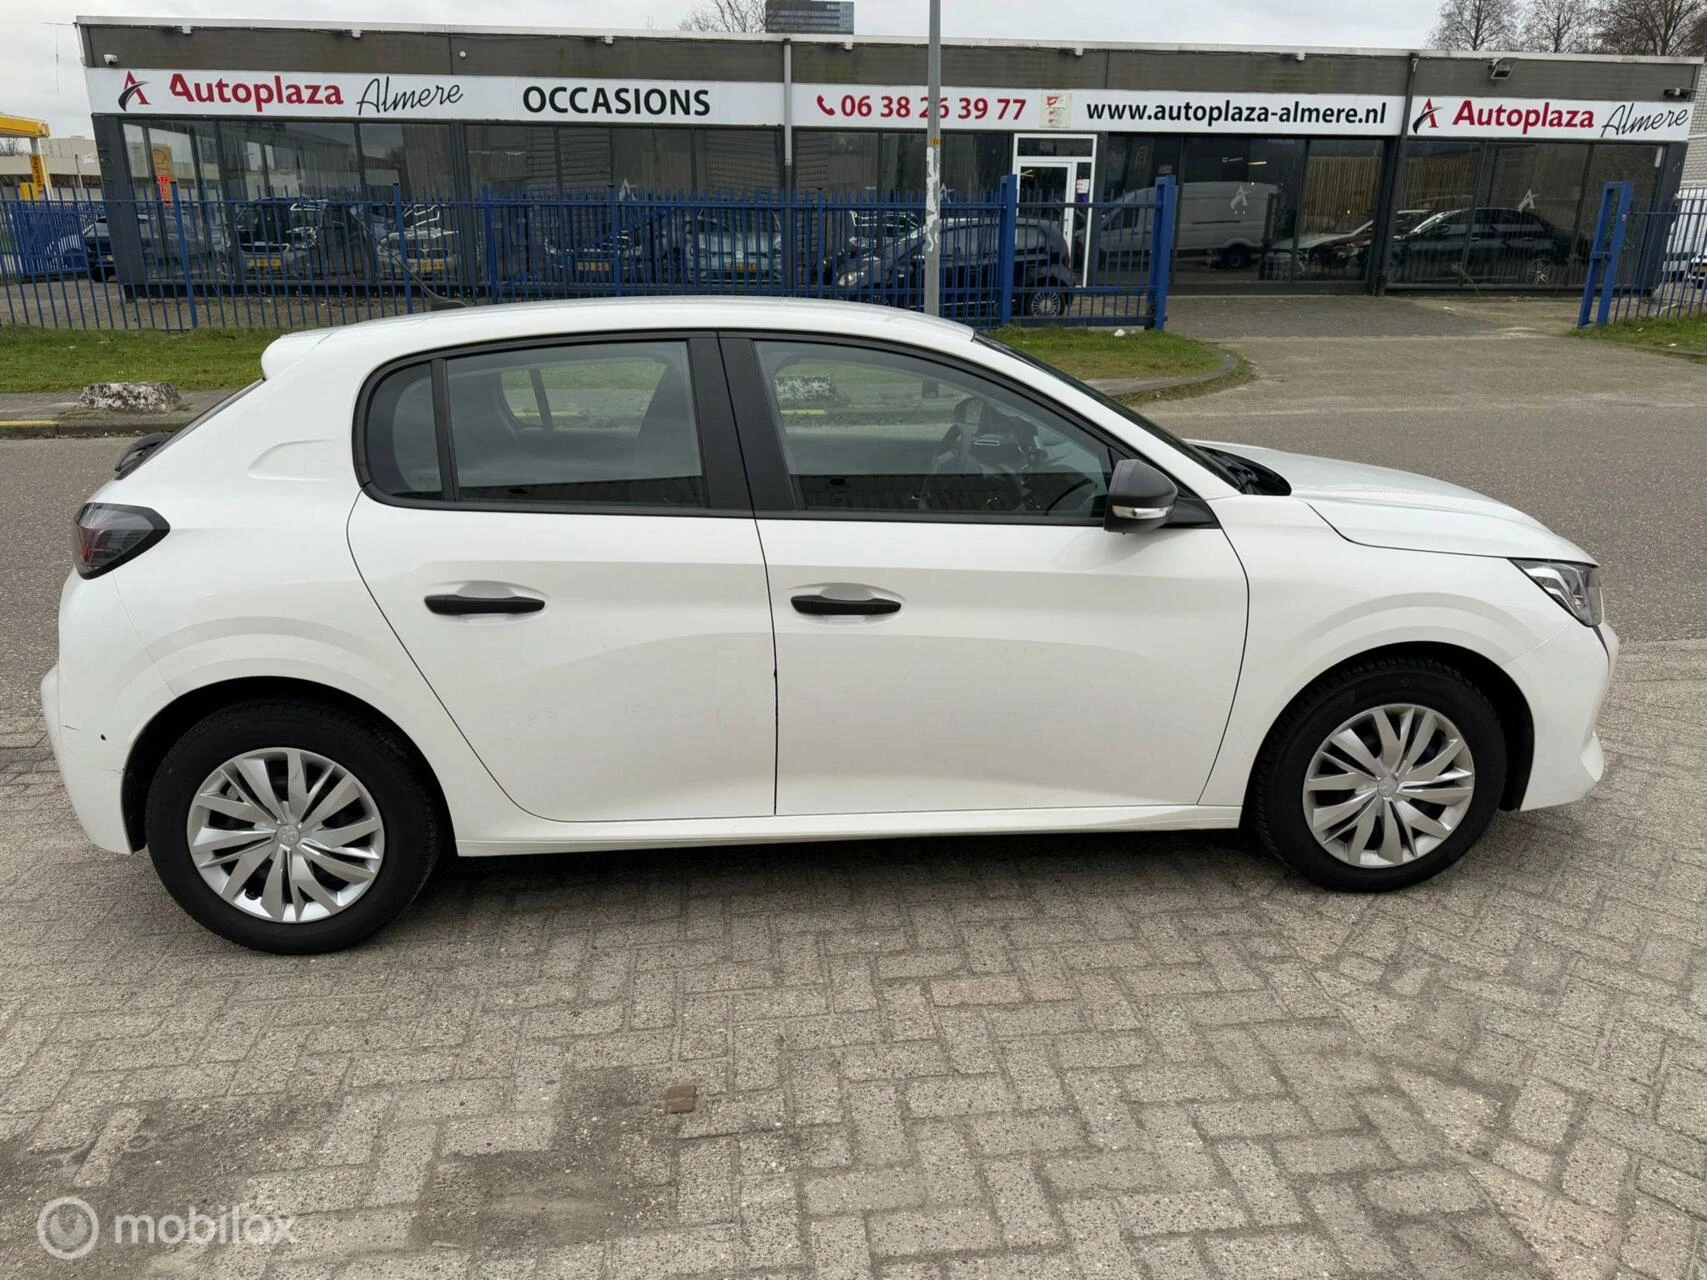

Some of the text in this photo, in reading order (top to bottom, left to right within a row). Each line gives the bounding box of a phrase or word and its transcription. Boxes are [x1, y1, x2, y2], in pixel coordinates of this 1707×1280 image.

[170, 73, 463, 115] Autoplaza Almere
[522, 85, 711, 117] OCCASIONS
[841, 95, 872, 118] 06
[880, 96, 911, 119] 38
[958, 97, 990, 120] 39
[997, 98, 1027, 120] 77
[1086, 99, 1387, 127] www.autoplaza-almere.nl
[1452, 99, 1690, 138] Autoplaza Almere
